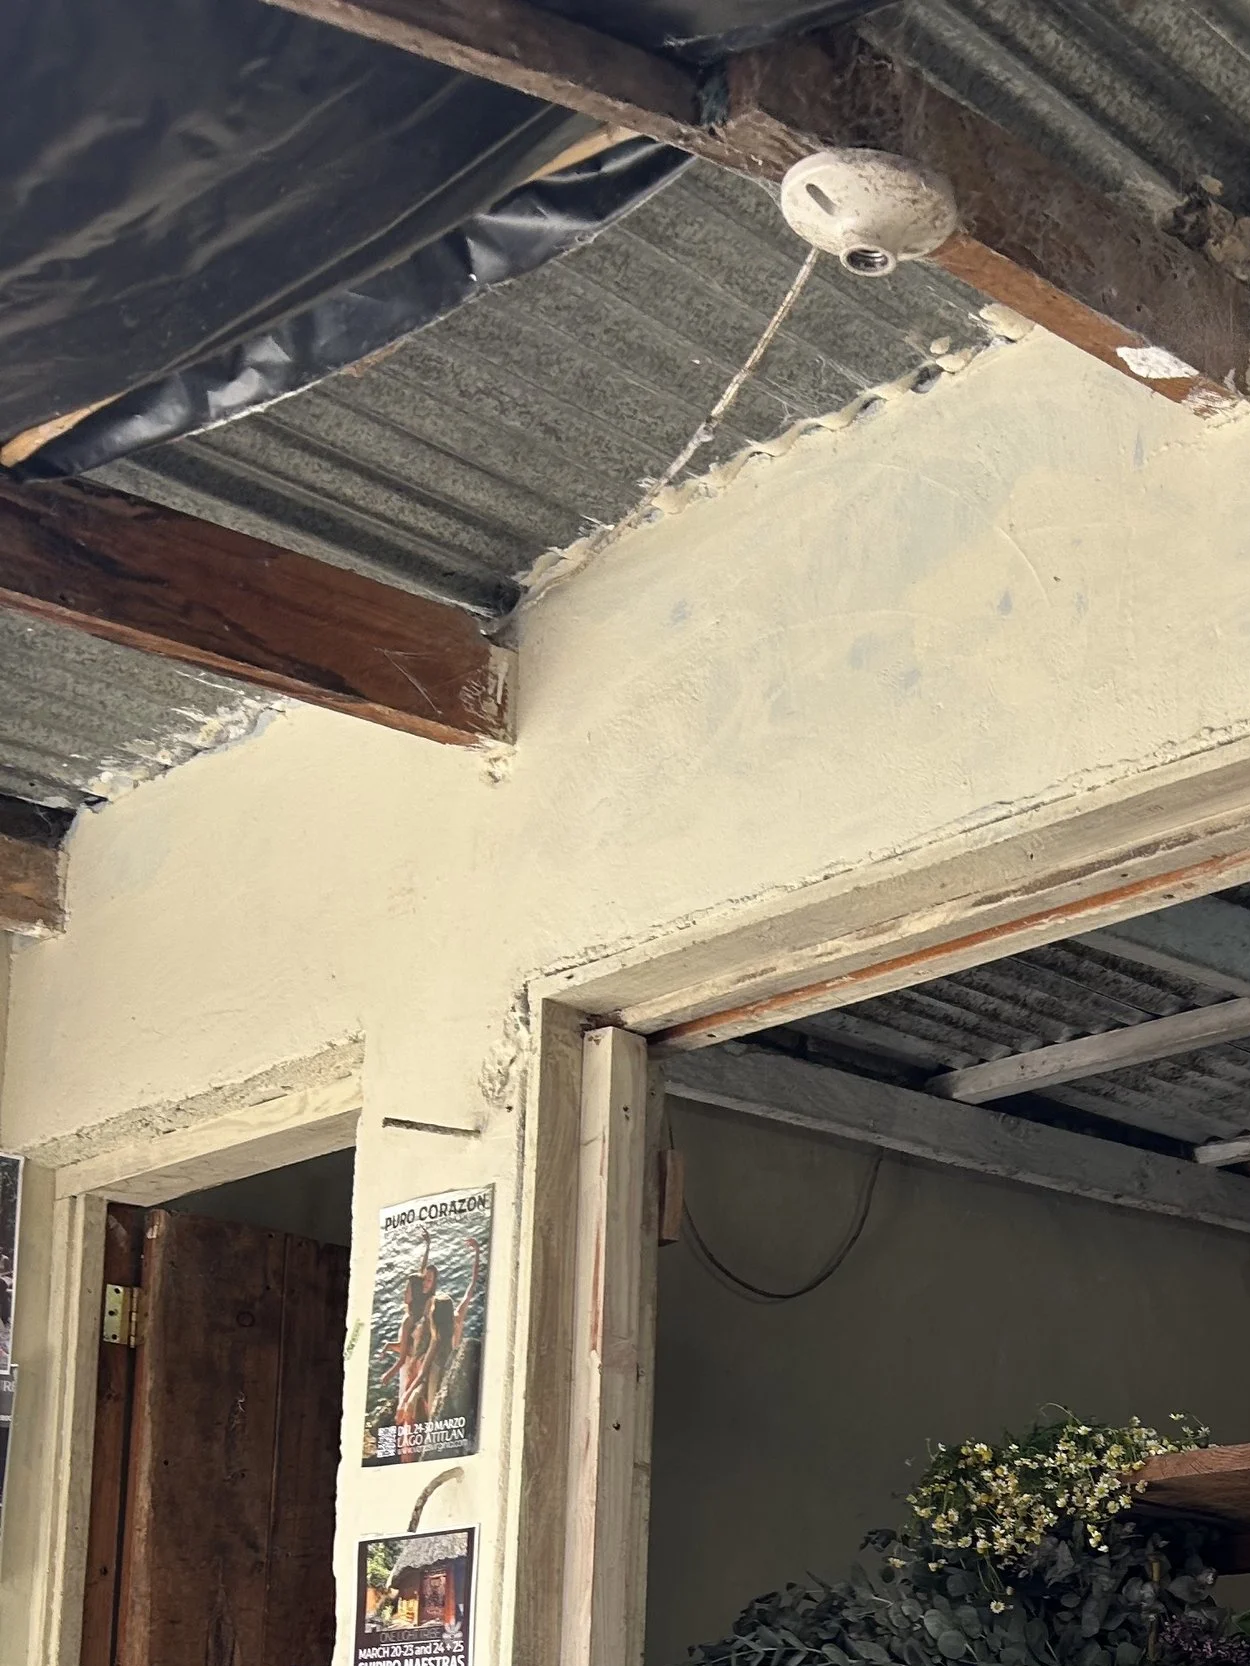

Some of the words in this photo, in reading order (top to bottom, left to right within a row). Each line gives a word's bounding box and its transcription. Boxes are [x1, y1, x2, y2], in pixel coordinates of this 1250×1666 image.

[385, 1209, 415, 1231] PURO
[419, 1193, 488, 1221] CORAZON
[397, 1424, 413, 1437] DEL
[435, 1416, 466, 1430] MARZO
[397, 1434, 423, 1448] LAGO
[424, 1428, 465, 1444] ATITLAN
[358, 1647, 390, 1660] MARCH
[390, 1645, 414, 1657] 20-23
[415, 1643, 432, 1655] and
[433, 1642, 445, 1654] 24
[452, 1641, 464, 1653] 25
